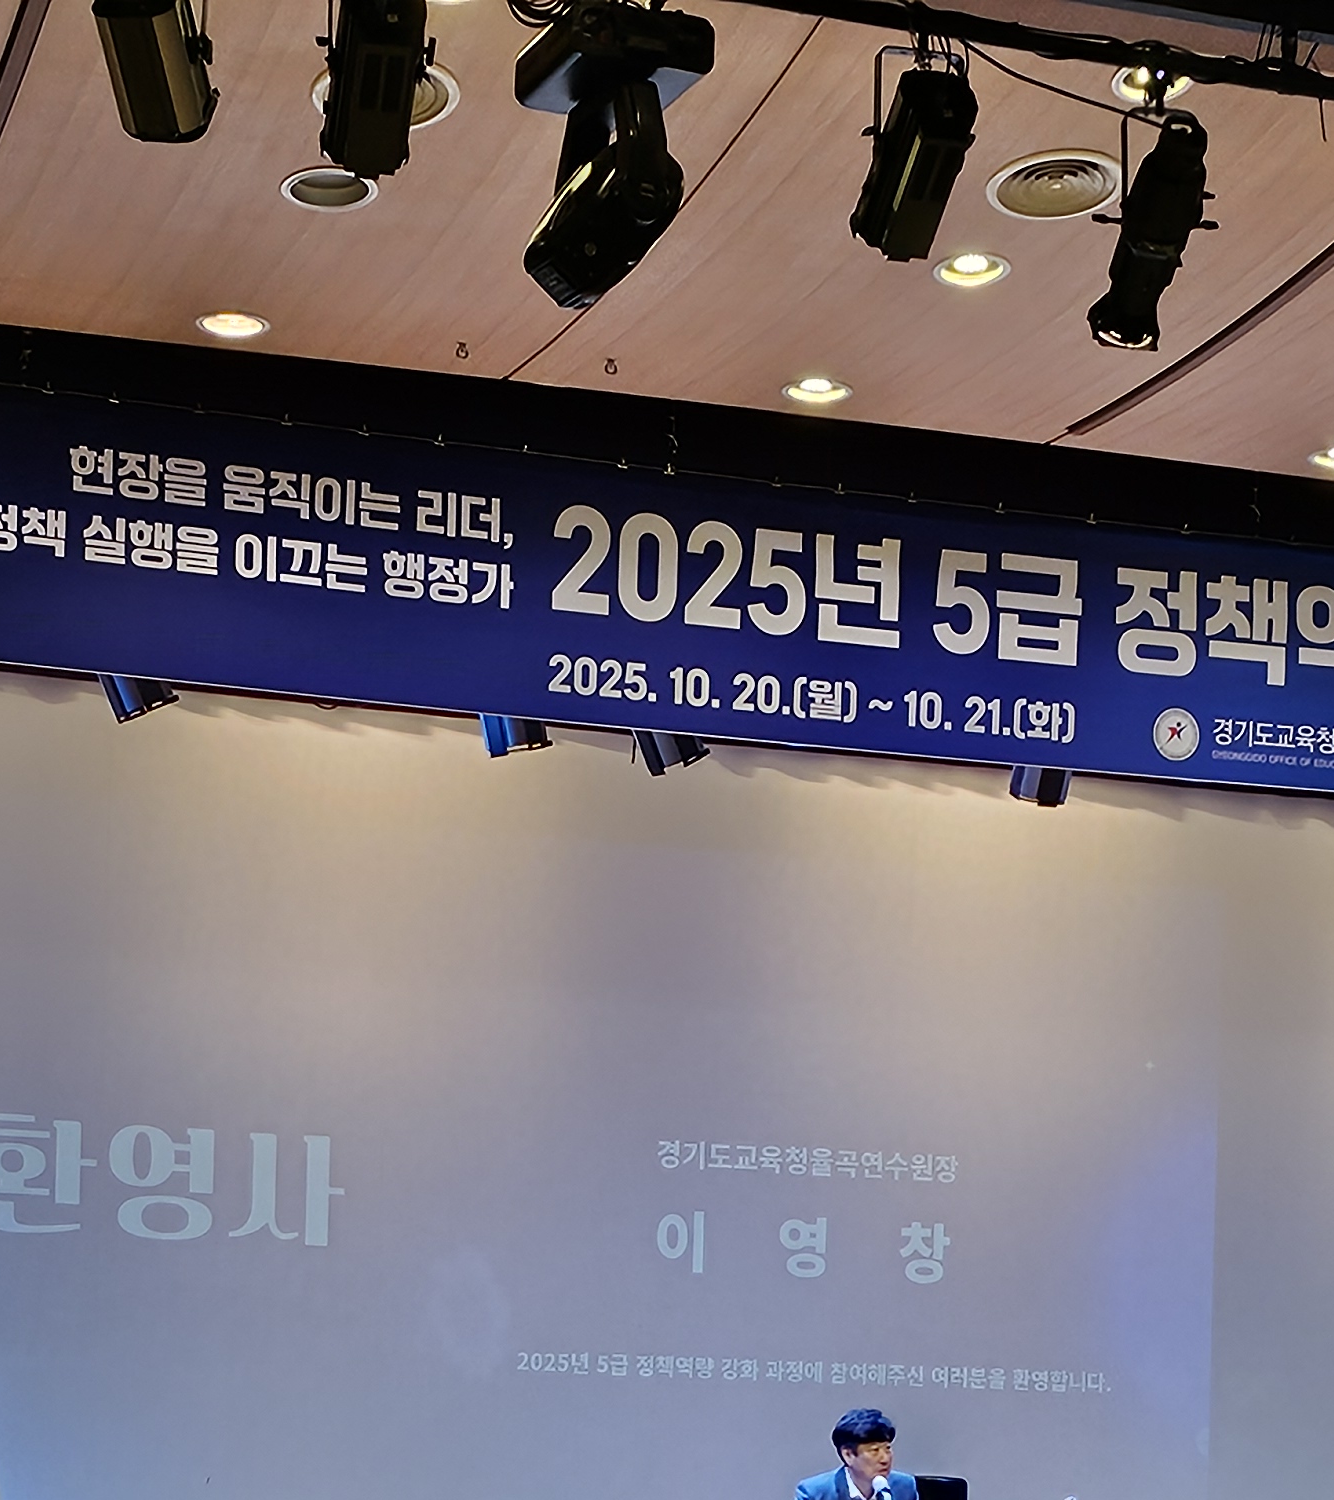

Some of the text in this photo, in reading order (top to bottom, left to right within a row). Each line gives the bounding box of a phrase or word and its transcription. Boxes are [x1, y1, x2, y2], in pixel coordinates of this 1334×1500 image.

[69, 445, 514, 549] 현장을 움직이는 리더,
[83, 514, 219, 576] 실행을
[235, 533, 368, 593] 이끄는
[382, 544, 515, 610] 행정가
[551, 504, 902, 649] 2025년
[932, 548, 1083, 667] 5급
[548, 654, 657, 703] 2025.
[669, 666, 720, 709] 10.
[903, 690, 952, 731] 10.
[656, 1139, 959, 1184] 경기도교육청율곡연수원장
[656, 1210, 951, 1284] 이 영 창
[516, 1351, 1112, 1394] 2025년 5급 정책역량 강화 과정에 참여해주신 여러분을 환영합니다.
